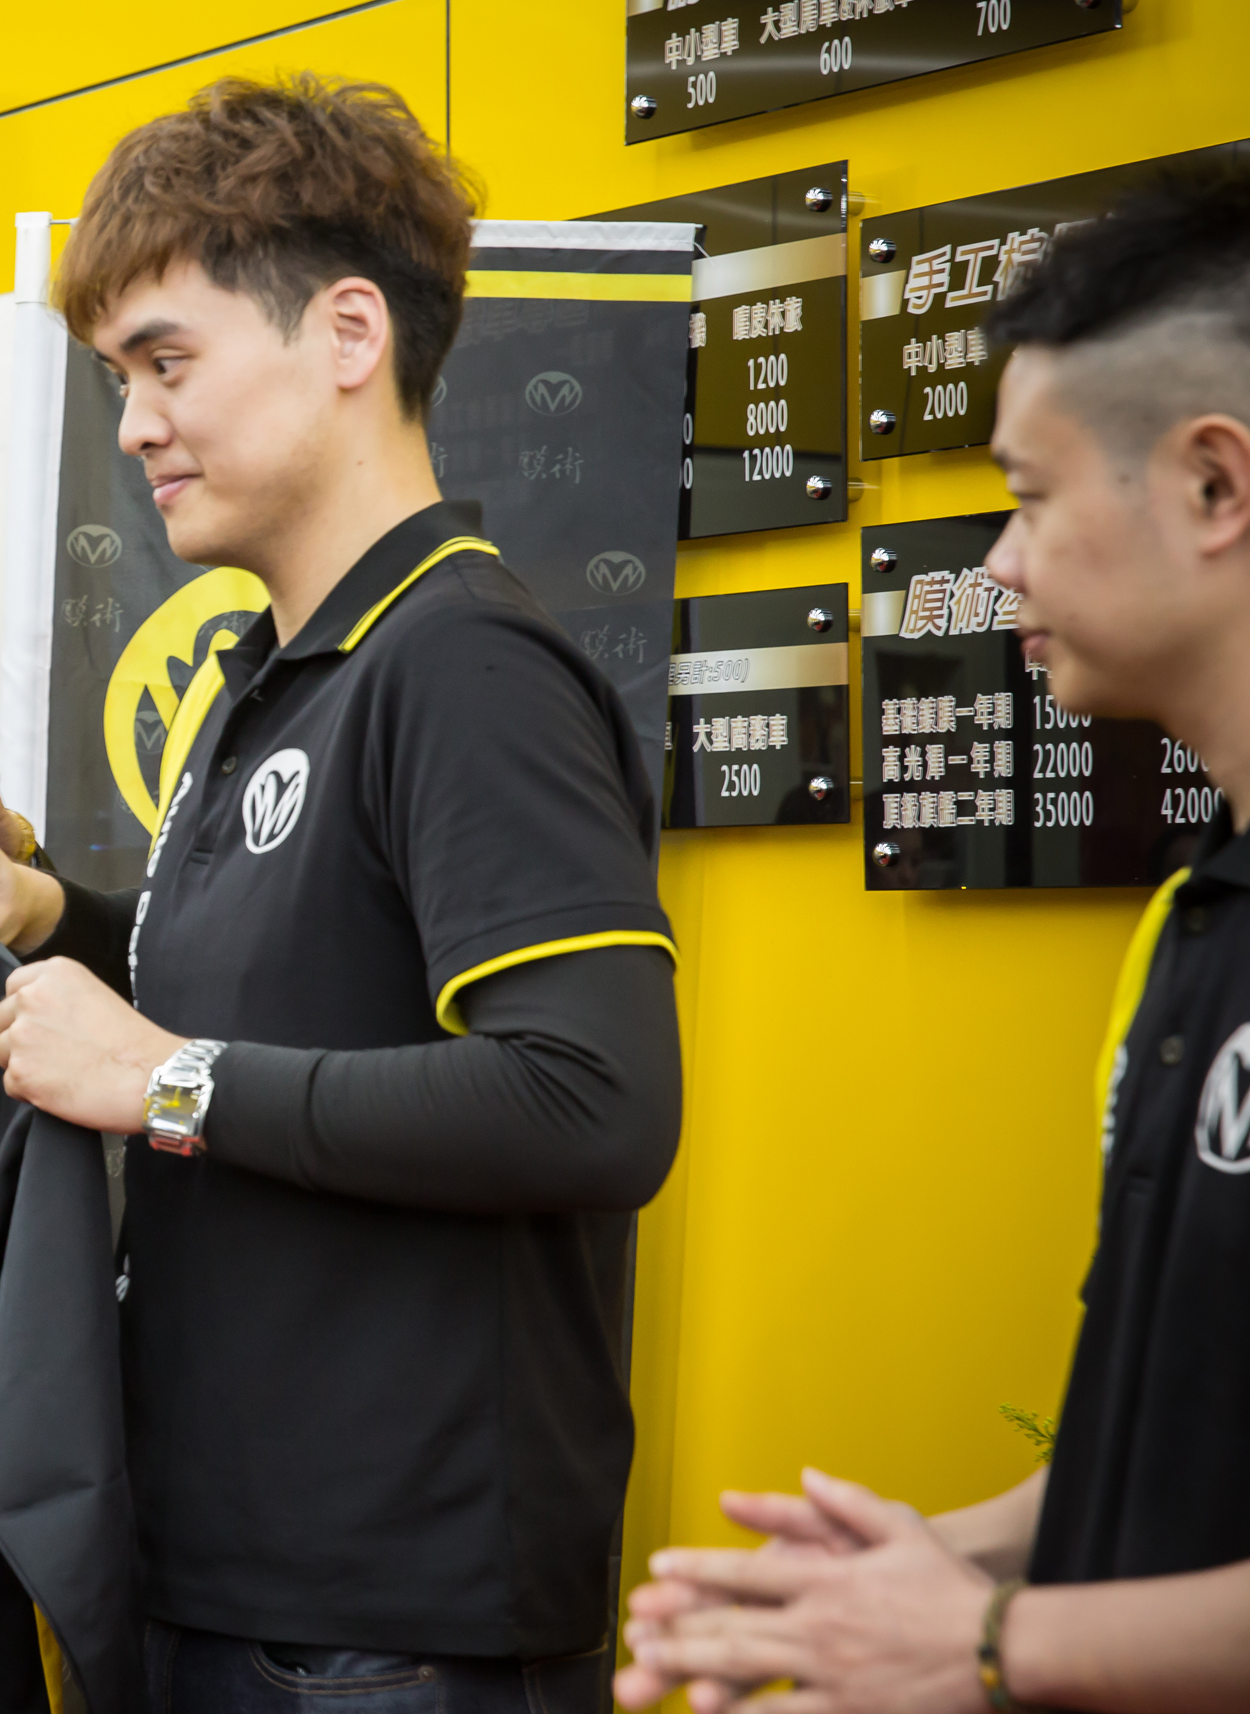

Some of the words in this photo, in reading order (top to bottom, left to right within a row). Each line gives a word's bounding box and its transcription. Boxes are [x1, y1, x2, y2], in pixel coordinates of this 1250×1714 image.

[664, 17, 740, 69] 中小型車
[686, 71, 717, 109] 500
[819, 36, 852, 75] 600
[976, 0, 1011, 36] 700
[903, 326, 988, 376] 中小型車
[747, 353, 788, 390] 1200
[746, 399, 788, 437] 8000
[923, 381, 968, 421] 2000
[742, 444, 794, 482] 12000
[692, 713, 788, 753] 大型商務車
[1032, 741, 1093, 779] 22000
[720, 763, 761, 797] 2500
[1033, 790, 1094, 828] 35000
